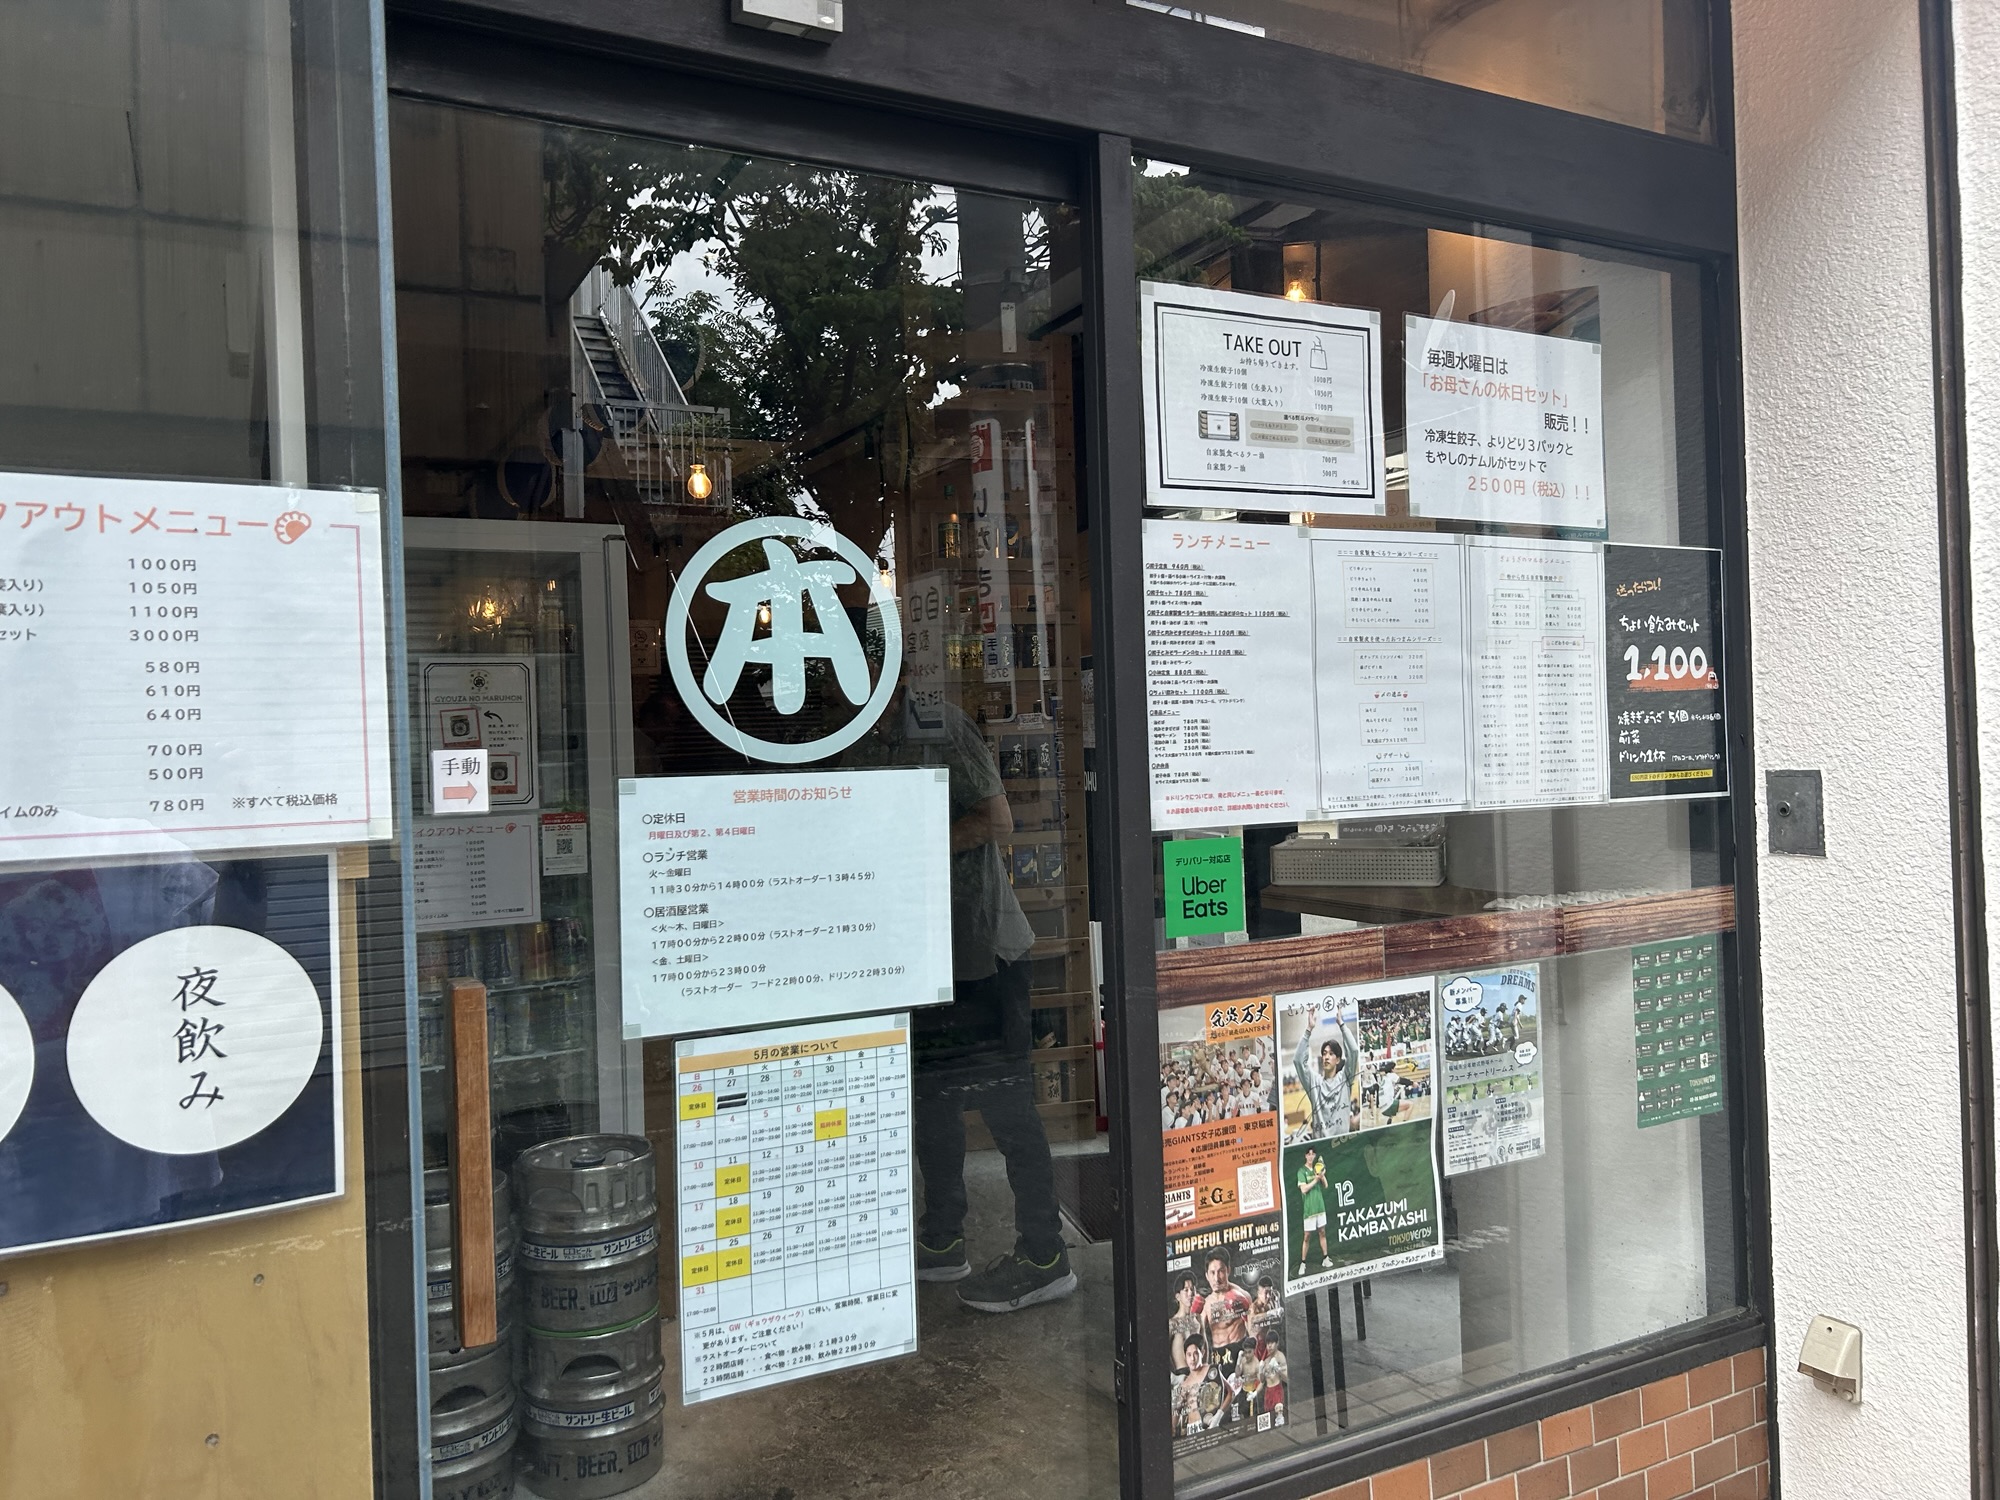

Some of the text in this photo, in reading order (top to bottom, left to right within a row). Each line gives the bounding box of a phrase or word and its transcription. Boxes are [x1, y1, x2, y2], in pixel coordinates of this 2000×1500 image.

[1223, 333, 1302, 358] TAKE OUT
[1199, 364, 1248, 376] 冷凍生餃子10個
[1239, 357, 1300, 371] お持ち帰りできます。
[1427, 348, 1508, 375] 毎週水曜日は
[1313, 375, 1333, 385] 1000円
[1314, 389, 1333, 398] 1050円
[1422, 372, 1568, 409] 「お母さんの休日セット」
[1314, 403, 1333, 412] 1100円
[1544, 413, 1589, 434] 販売!!
[1424, 428, 1574, 456] 冷凍生餃子、よりどり3パックと
[1206, 448, 1265, 460] 自家製食べるラー油
[1322, 455, 1338, 464] 700円
[1425, 450, 1547, 473] もやしのナムルがセットで
[1206, 462, 1246, 473] 自家製ラー油
[1322, 469, 1338, 478] 500円
[1468, 475, 1590, 501] 2500円(税込)!!
[1172, 533, 1270, 550] ランチメニュー
[127, 558, 197, 572] 1000円
[128, 582, 198, 595] 1050円
[129, 606, 199, 619] 1100円
[1619, 614, 1700, 634] ちょい飲みセット
[129, 629, 199, 642] 3000円
[145, 661, 200, 674] 580円
[146, 685, 201, 698] 610円
[435, 695, 467, 703] GYOUZA
[482, 694, 523, 702] MARUHON
[146, 708, 202, 721] 640円
[1618, 709, 1689, 726] 焼きぎょうざ 5個
[1618, 729, 1640, 745] 前菜
[147, 744, 203, 757] 700円
[1619, 748, 1666, 763] ドリンク1杯
[148, 767, 204, 780] 500円
[440, 757, 482, 776] 手動
[149, 793, 338, 812] 780円 ※すべて税込価格
[733, 786, 853, 805] 営業時間のお知らせ
[642, 812, 686, 825] ○定休日
[648, 826, 756, 840] 月曜日及び第2、第4日曜日
[642, 850, 708, 864] ○ランチ営業
[1175, 854, 1231, 867] デリバリー対応店
[650, 871, 877, 895] 11時30分から14時00分(ラストオーダー13時45分)
[1181, 876, 1227, 896] Uber
[644, 903, 710, 919] ○居酒屋営業
[1183, 898, 1228, 919] Eats
[651, 922, 877, 950] 17時00分から22時00分(ラストオーダー21時30分)
[652, 963, 767, 983] 17時00分から23時00分
[1449, 987, 1478, 996] 新メンバー
[1500, 974, 1536, 993] DREAMS
[172, 966, 228, 1110] 夜飲み
[753, 1040, 839, 1060] 5月の営業について
[692, 1084, 703, 1092] 26
[727, 1079, 737, 1087] 27
[760, 1074, 770, 1082] 28
[793, 1070, 802, 1078] 29
[825, 1065, 834, 1073] 30
[859, 1061, 864, 1069] 1
[728, 1068, 735, 1076] 月
[688, 1102, 707, 1111] 定休日
[696, 1120, 701, 1128] 3
[828, 1100, 833, 1108] 7
[891, 1091, 895, 1099] 9
[1163, 1118, 1274, 1147] 売GIANTS女子応援団・東京稲城
[694, 1130, 898, 1170] 10 11 12 13 14 15 16
[724, 1176, 741, 1185] 定休日
[694, 1169, 898, 1212] 17 18 19 20 21 22 23
[1334, 1180, 1355, 1208] 12
[1337, 1197, 1408, 1227] TAKAZUMI
[725, 1217, 742, 1226] 定休日
[1338, 1208, 1428, 1243] KAMBAYASHI
[695, 1208, 898, 1253] 24 25 26 27 28 29 30
[1174, 1221, 1280, 1255] HOPEFUL FIGHT VOL 45
[604, 1228, 654, 1255] サントリー生ビール
[691, 1259, 743, 1275] 定休日 定休日
[696, 1286, 705, 1295] 31
[694, 1339, 778, 1363] ※ラストオーダーについて
[565, 1404, 633, 1426] サントリー生ビール
